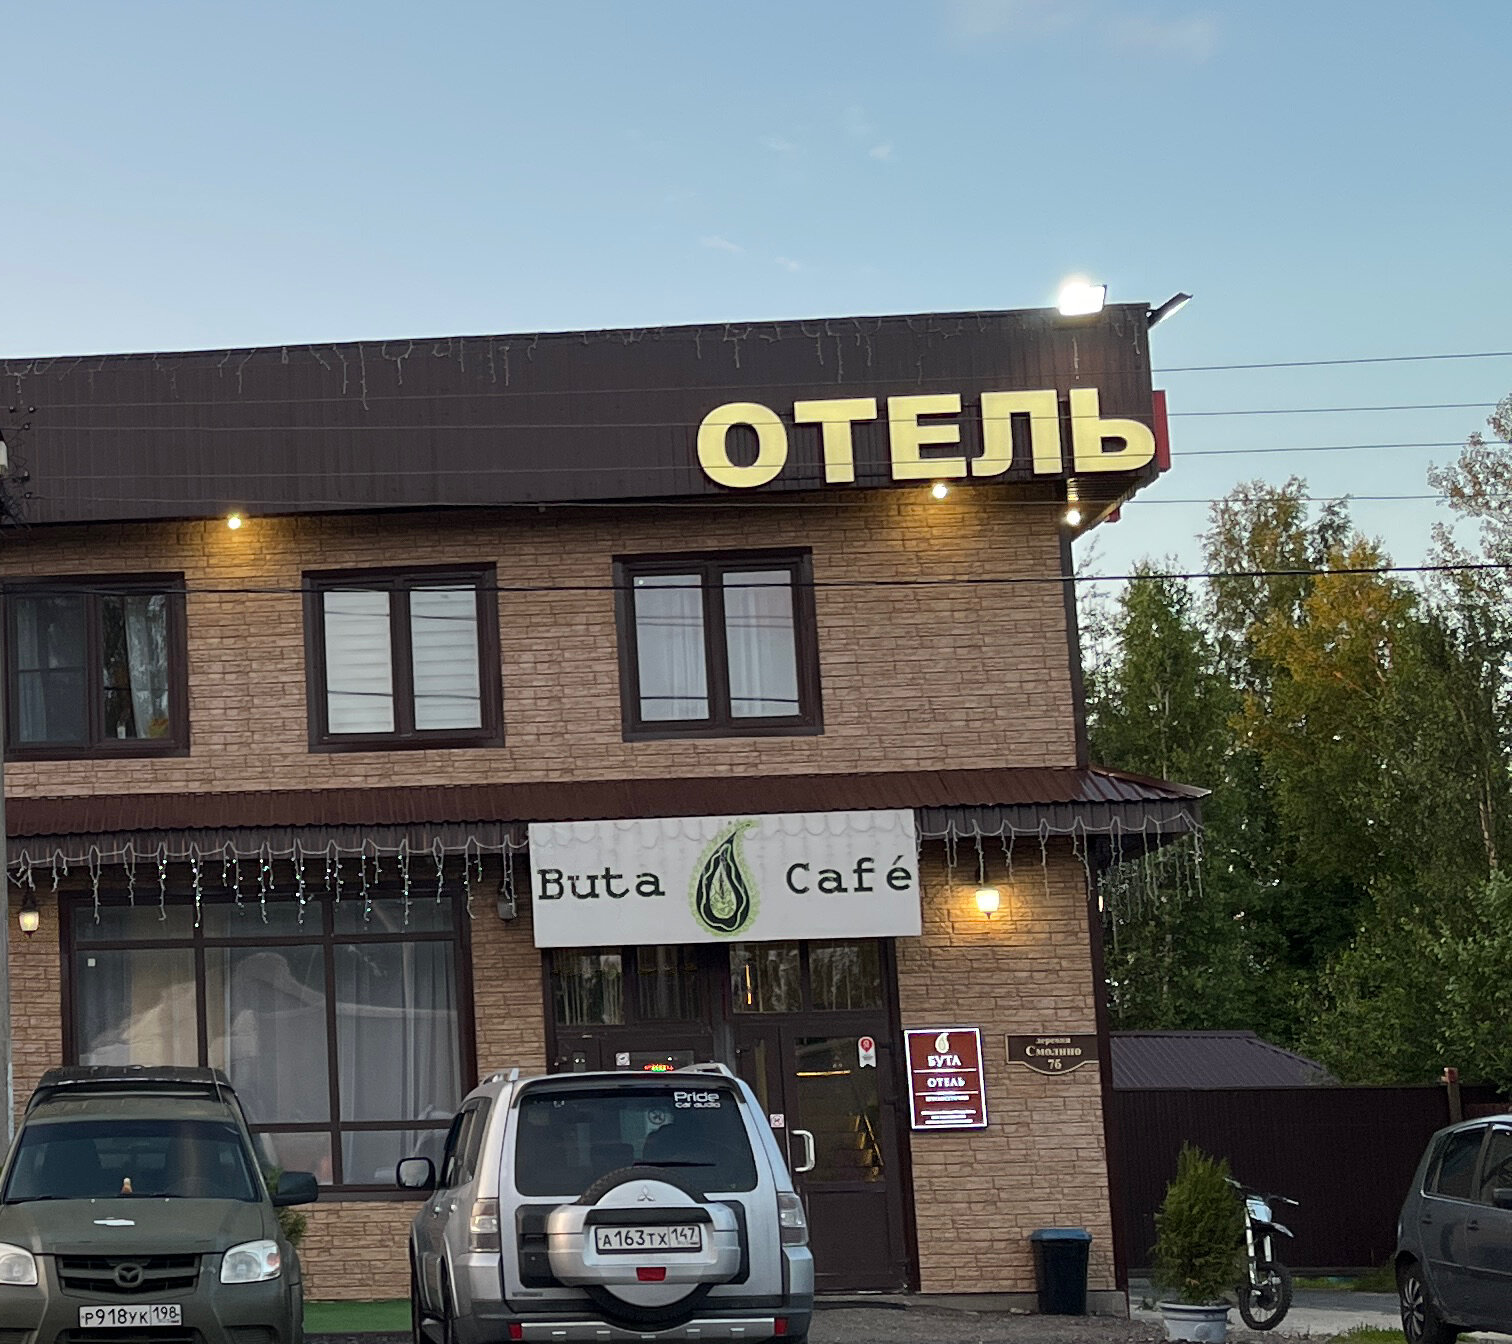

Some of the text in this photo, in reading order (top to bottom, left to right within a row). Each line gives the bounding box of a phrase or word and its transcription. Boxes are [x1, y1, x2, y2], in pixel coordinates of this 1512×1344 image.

[696, 388, 1156, 488] ОТЕЛЬ
[537, 855, 913, 901] Buta Café
[1025, 1045, 1082, 1057] Смолино
[927, 1054, 962, 1068] БУТА
[926, 1076, 966, 1088] ОТЕЛЬ
[673, 1091, 720, 1102] Pride
